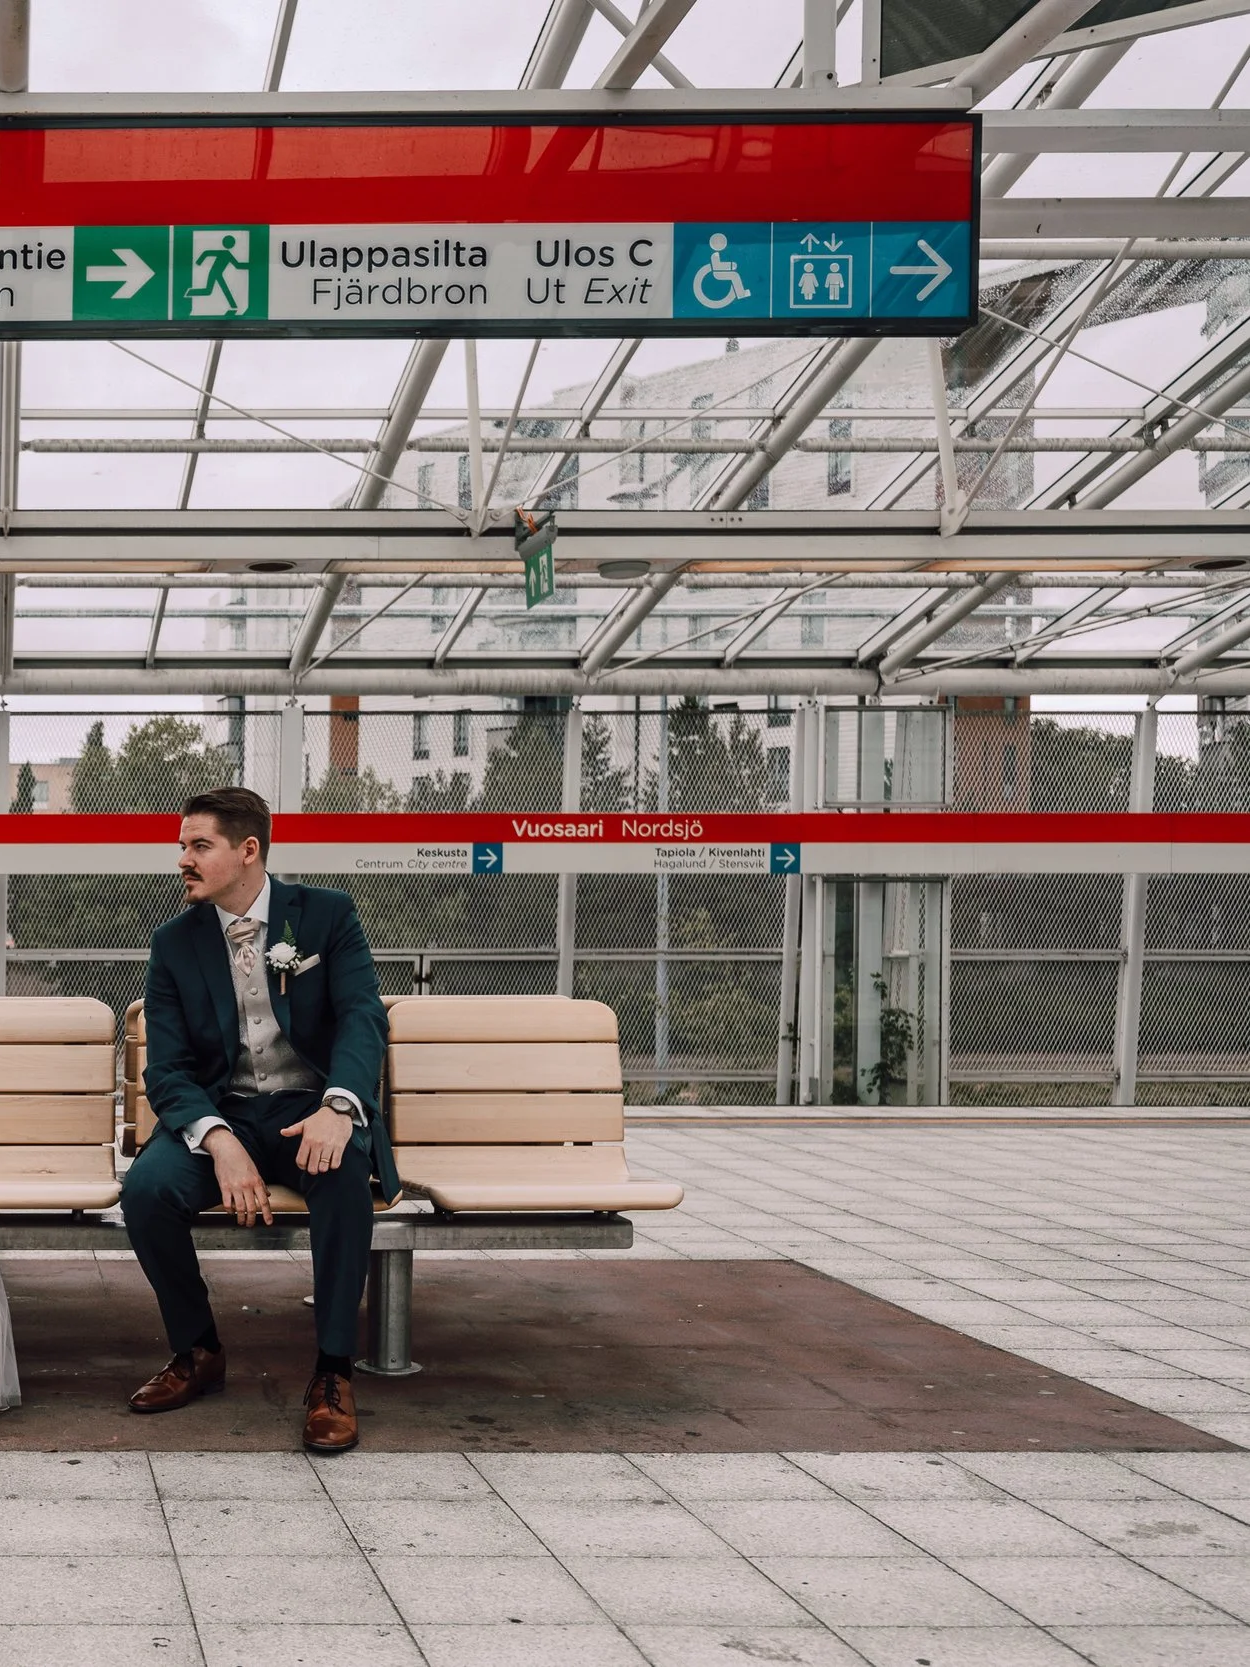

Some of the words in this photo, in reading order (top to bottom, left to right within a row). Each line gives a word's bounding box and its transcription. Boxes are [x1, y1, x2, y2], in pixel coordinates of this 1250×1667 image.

[281, 238, 488, 274] Ulappasilta
[536, 238, 615, 268] Ulos
[628, 238, 653, 267] C
[313, 276, 487, 311] Fjärdbron
[526, 277, 566, 305] Ut
[583, 276, 653, 305] Exit
[512, 819, 603, 838] Vuosaari
[622, 819, 703, 840] Nordsjö
[416, 848, 468, 858] Keskusta
[654, 848, 696, 859] Tapiola
[708, 848, 765, 858] Kivenlahti
[355, 859, 404, 869] Centrum
[406, 859, 430, 871] City
[431, 860, 468, 869] centre
[653, 859, 707, 871] Hagalund
[718, 859, 765, 869] Stensvik
